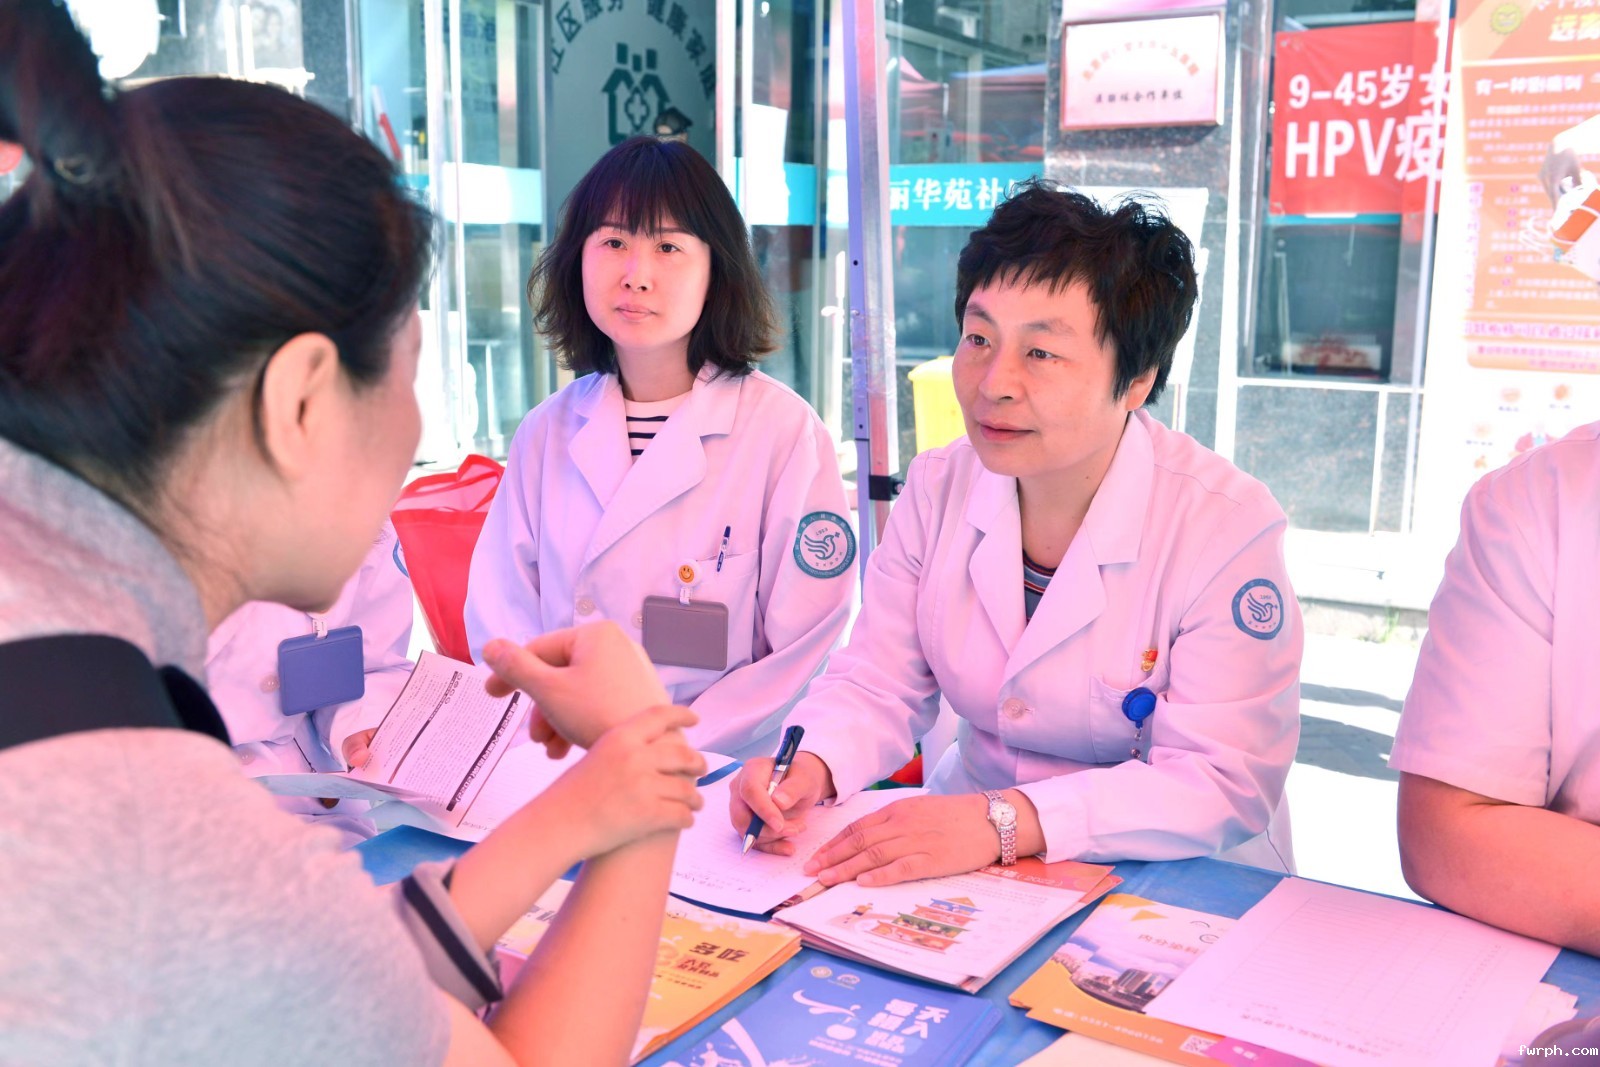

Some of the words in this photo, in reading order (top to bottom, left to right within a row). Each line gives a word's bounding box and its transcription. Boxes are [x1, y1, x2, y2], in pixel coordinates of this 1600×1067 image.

[889, 177, 1017, 211] 丽华苑社
[688, 941, 749, 962] 多吃
